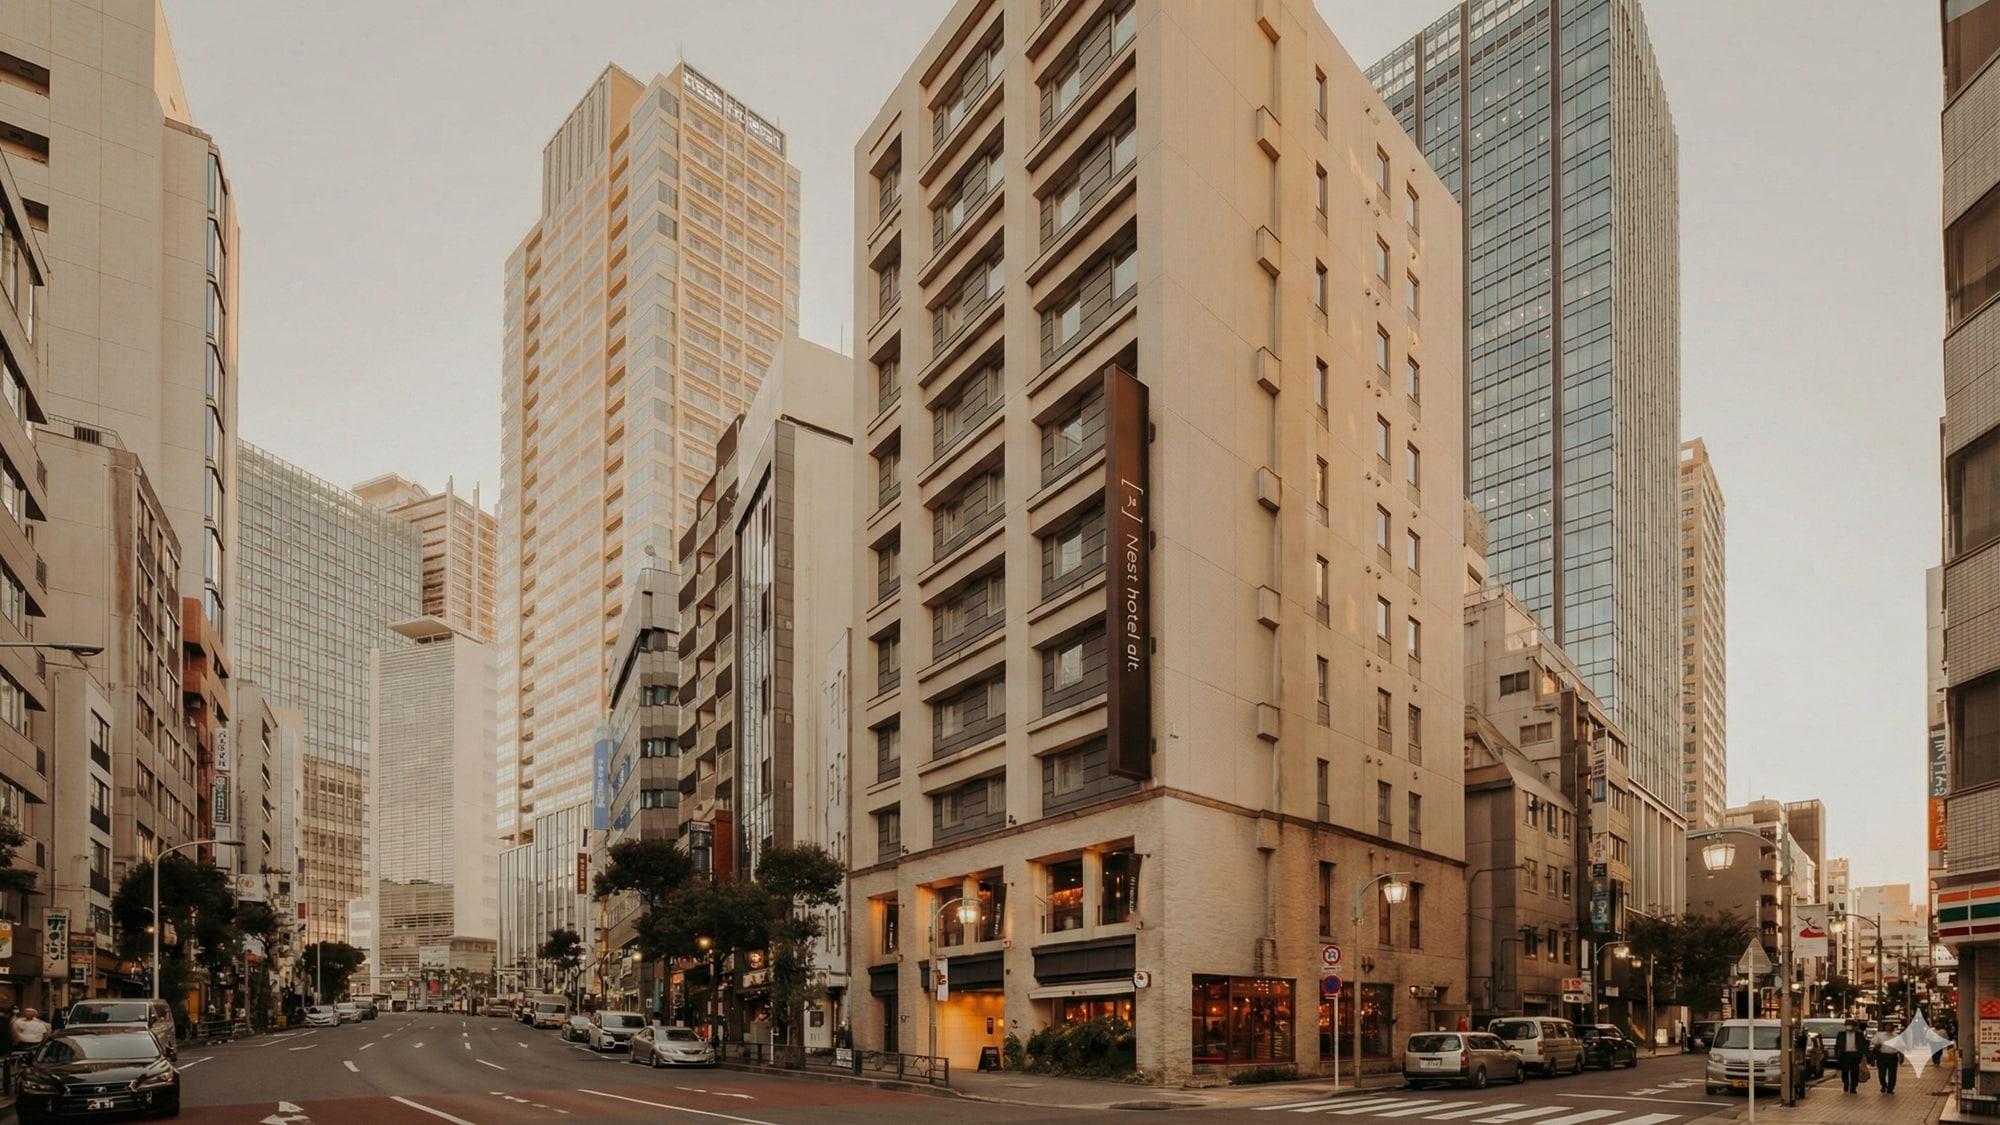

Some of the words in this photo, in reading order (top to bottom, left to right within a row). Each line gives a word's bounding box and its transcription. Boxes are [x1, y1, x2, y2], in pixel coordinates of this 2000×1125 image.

[1126, 533, 1139, 582] Nest
[1127, 587, 1141, 640] hotel
[1127, 644, 1140, 672] alt.
